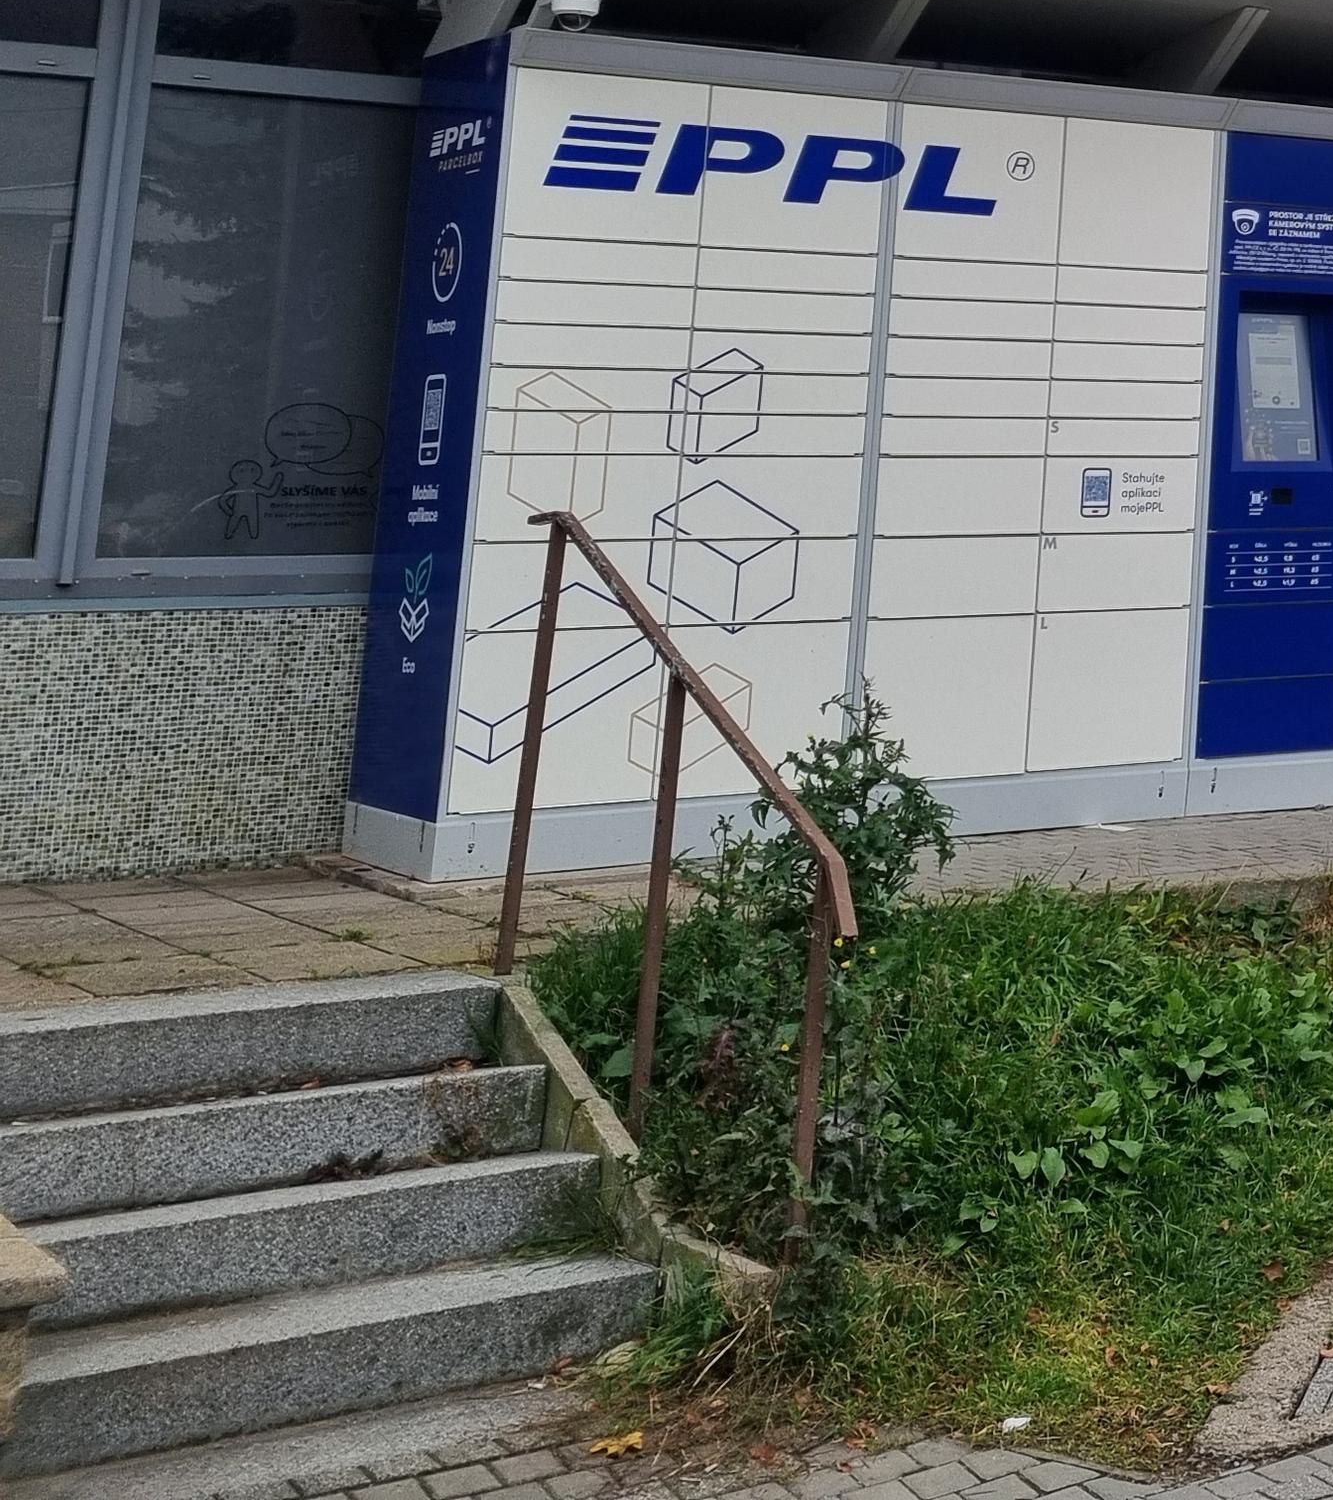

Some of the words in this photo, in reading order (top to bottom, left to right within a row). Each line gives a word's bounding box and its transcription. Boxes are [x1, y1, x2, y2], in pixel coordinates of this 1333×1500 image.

[441, 119, 486, 155] PPL
[438, 150, 484, 172] PARCELBOX
[655, 124, 997, 216] PPL
[438, 247, 454, 276] 24
[426, 319, 456, 335] Nonstop
[1050, 421, 1060, 433] S
[1122, 472, 1165, 488] Stahujte
[1121, 487, 1161, 503] aplikaci
[1120, 502, 1164, 516] mojePPL
[1043, 538, 1057, 550] M
[1041, 616, 1048, 629] L
[402, 657, 415, 673] Eco
